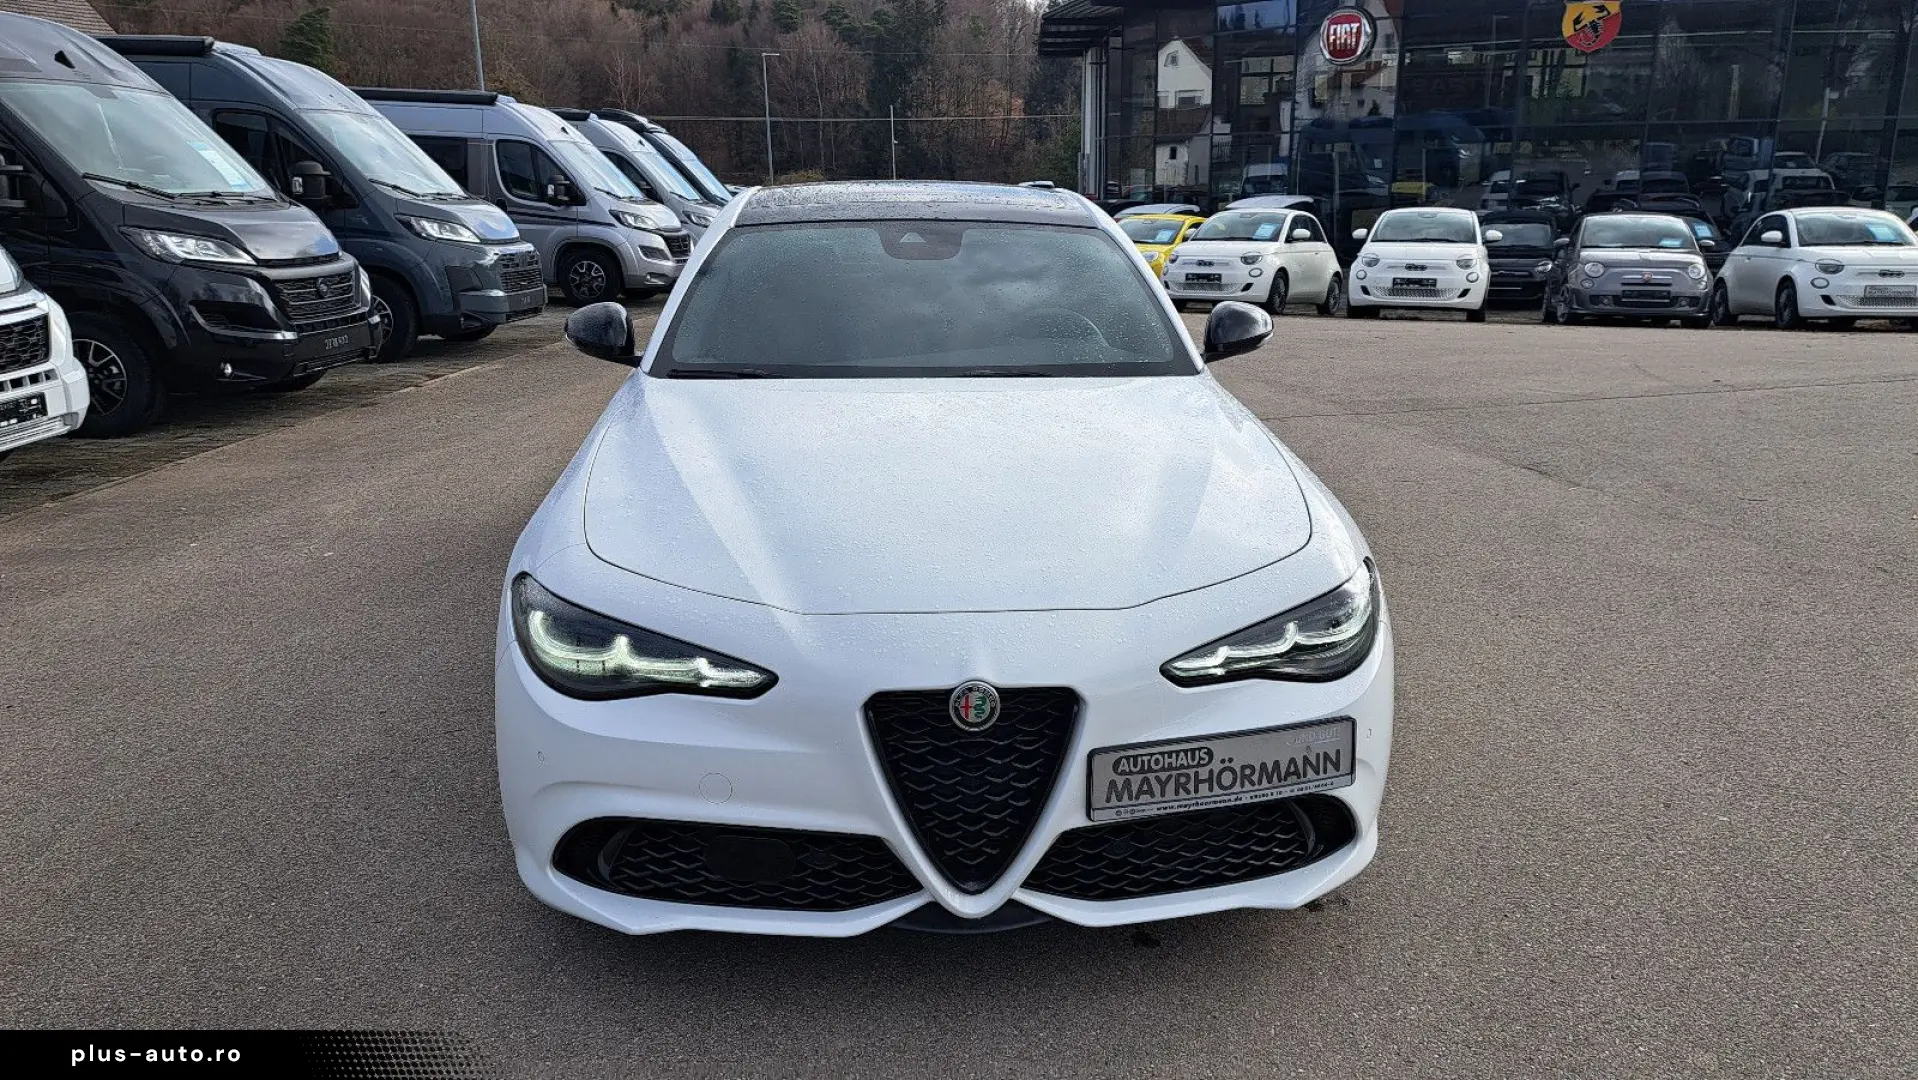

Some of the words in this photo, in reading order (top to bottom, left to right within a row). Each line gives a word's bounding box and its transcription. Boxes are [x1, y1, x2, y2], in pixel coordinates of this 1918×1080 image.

[1329, 22, 1361, 50] FIAT
[1117, 748, 1209, 773] AUTOHAUS
[1105, 748, 1341, 804] MAYRHÖRMANN
